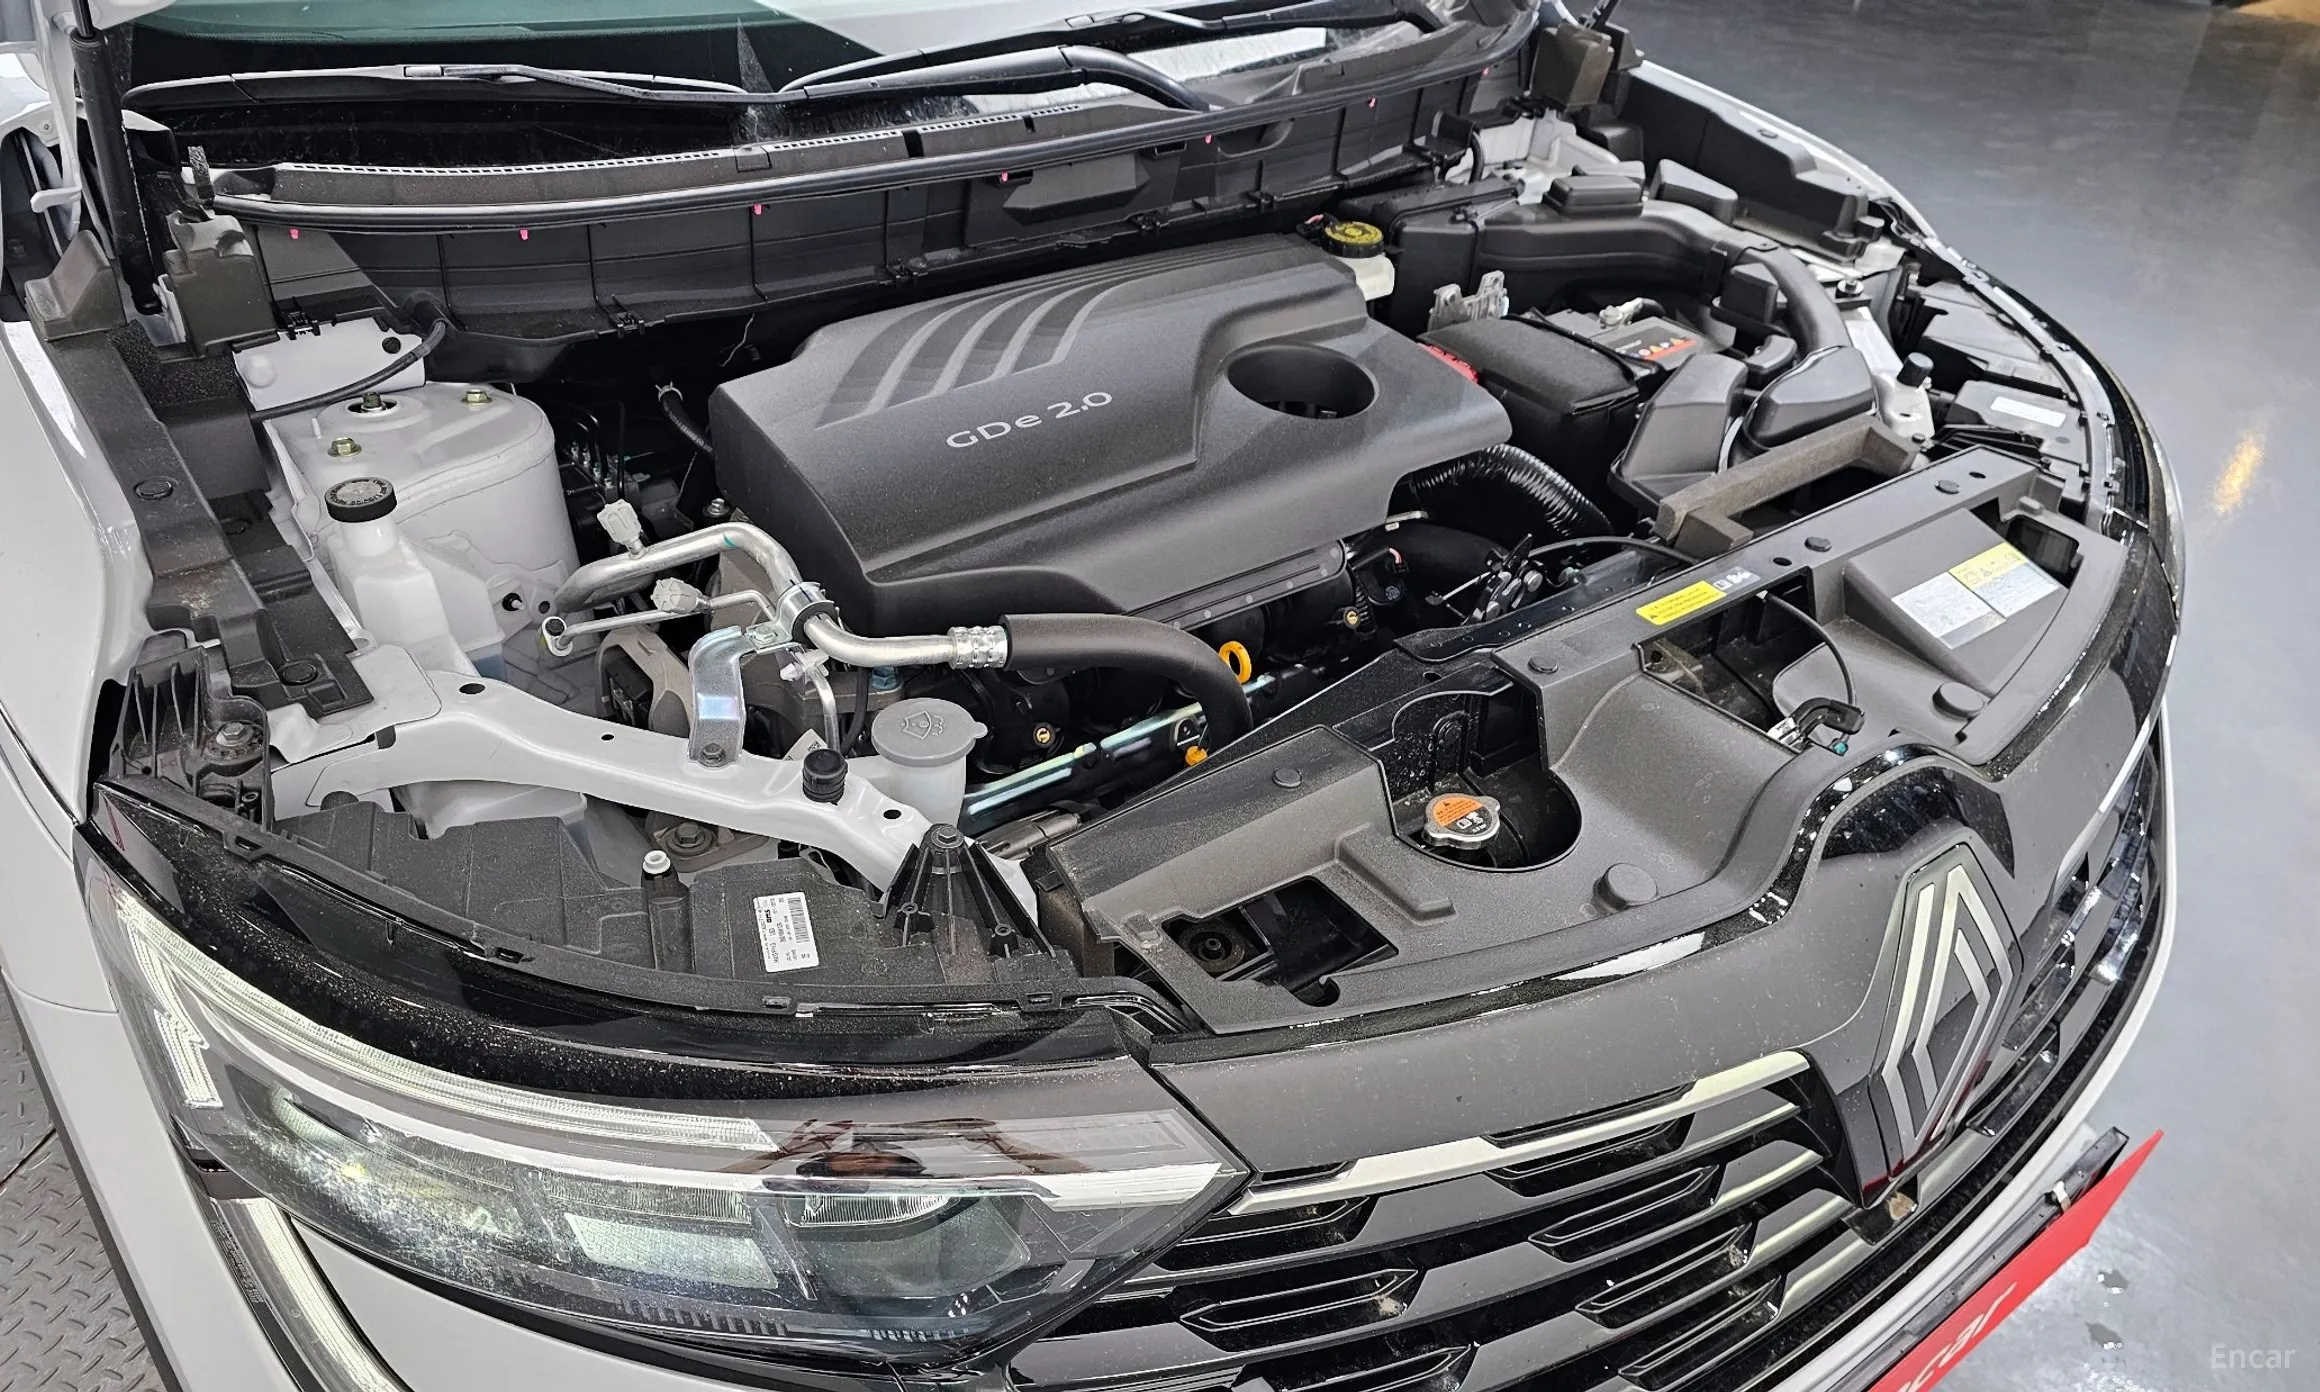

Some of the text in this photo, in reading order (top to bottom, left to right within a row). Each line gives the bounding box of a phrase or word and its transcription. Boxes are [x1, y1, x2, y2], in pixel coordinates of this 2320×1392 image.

[946, 392, 1112, 448] GDe 2.0
[1897, 1281, 2018, 1392] car
